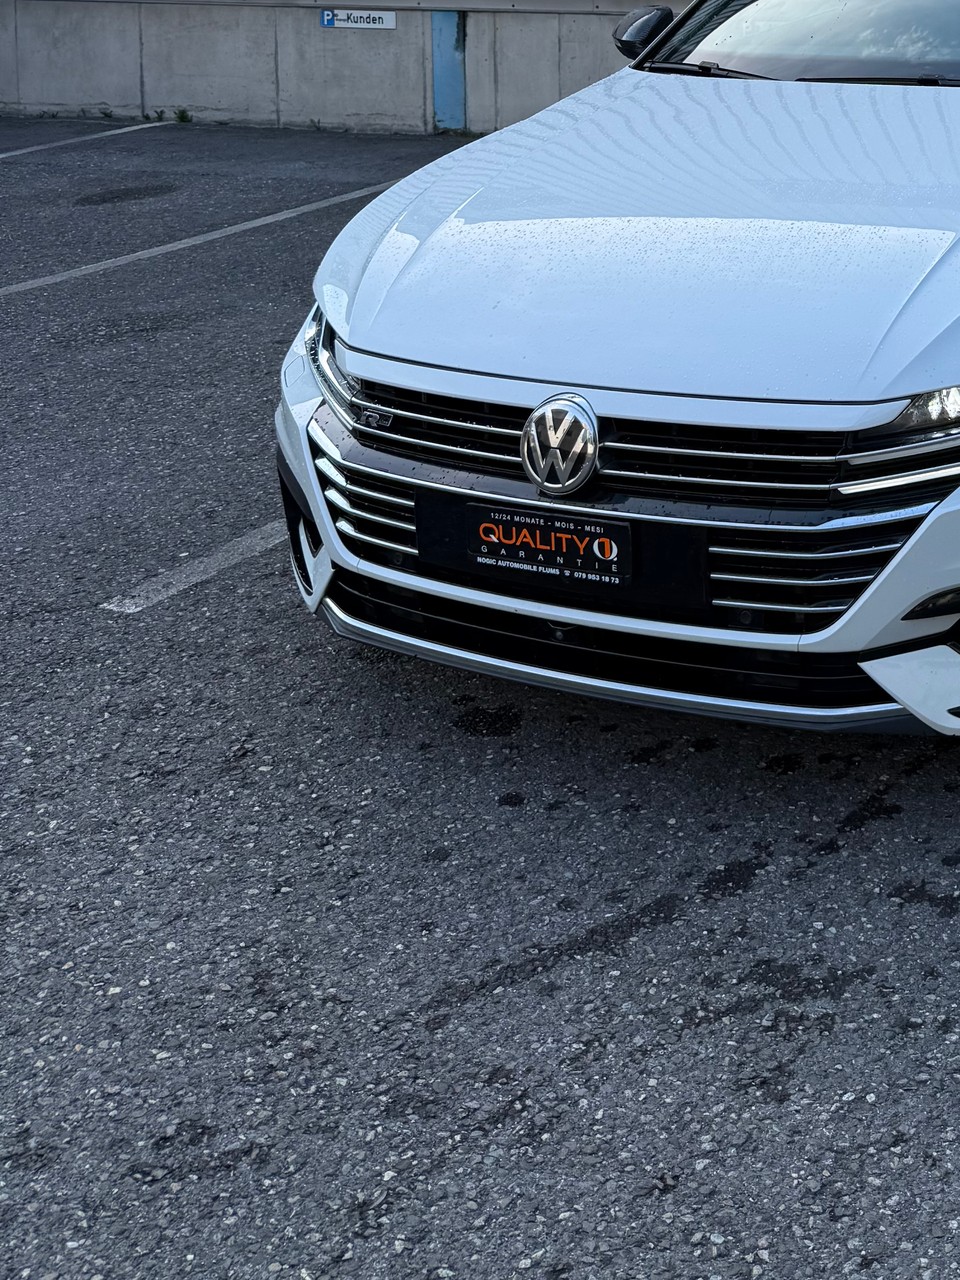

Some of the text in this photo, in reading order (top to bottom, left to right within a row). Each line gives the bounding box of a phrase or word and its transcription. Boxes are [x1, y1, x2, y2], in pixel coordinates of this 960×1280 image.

[323, 11, 333, 25] P
[346, 12, 384, 25] Kunden
[523, 400, 596, 494] VW
[490, 512, 511, 521] 12/24
[513, 515, 545, 526] MONATE
[554, 521, 575, 530] MOIS
[584, 525, 604, 534] MESI
[479, 522, 590, 556] QUALITY
[481, 545, 618, 572] GARANTIE
[497, 559, 538, 572] AUTOMOBILE
[538, 566, 560, 576] FLUMS
[574, 571, 587, 579] 079
